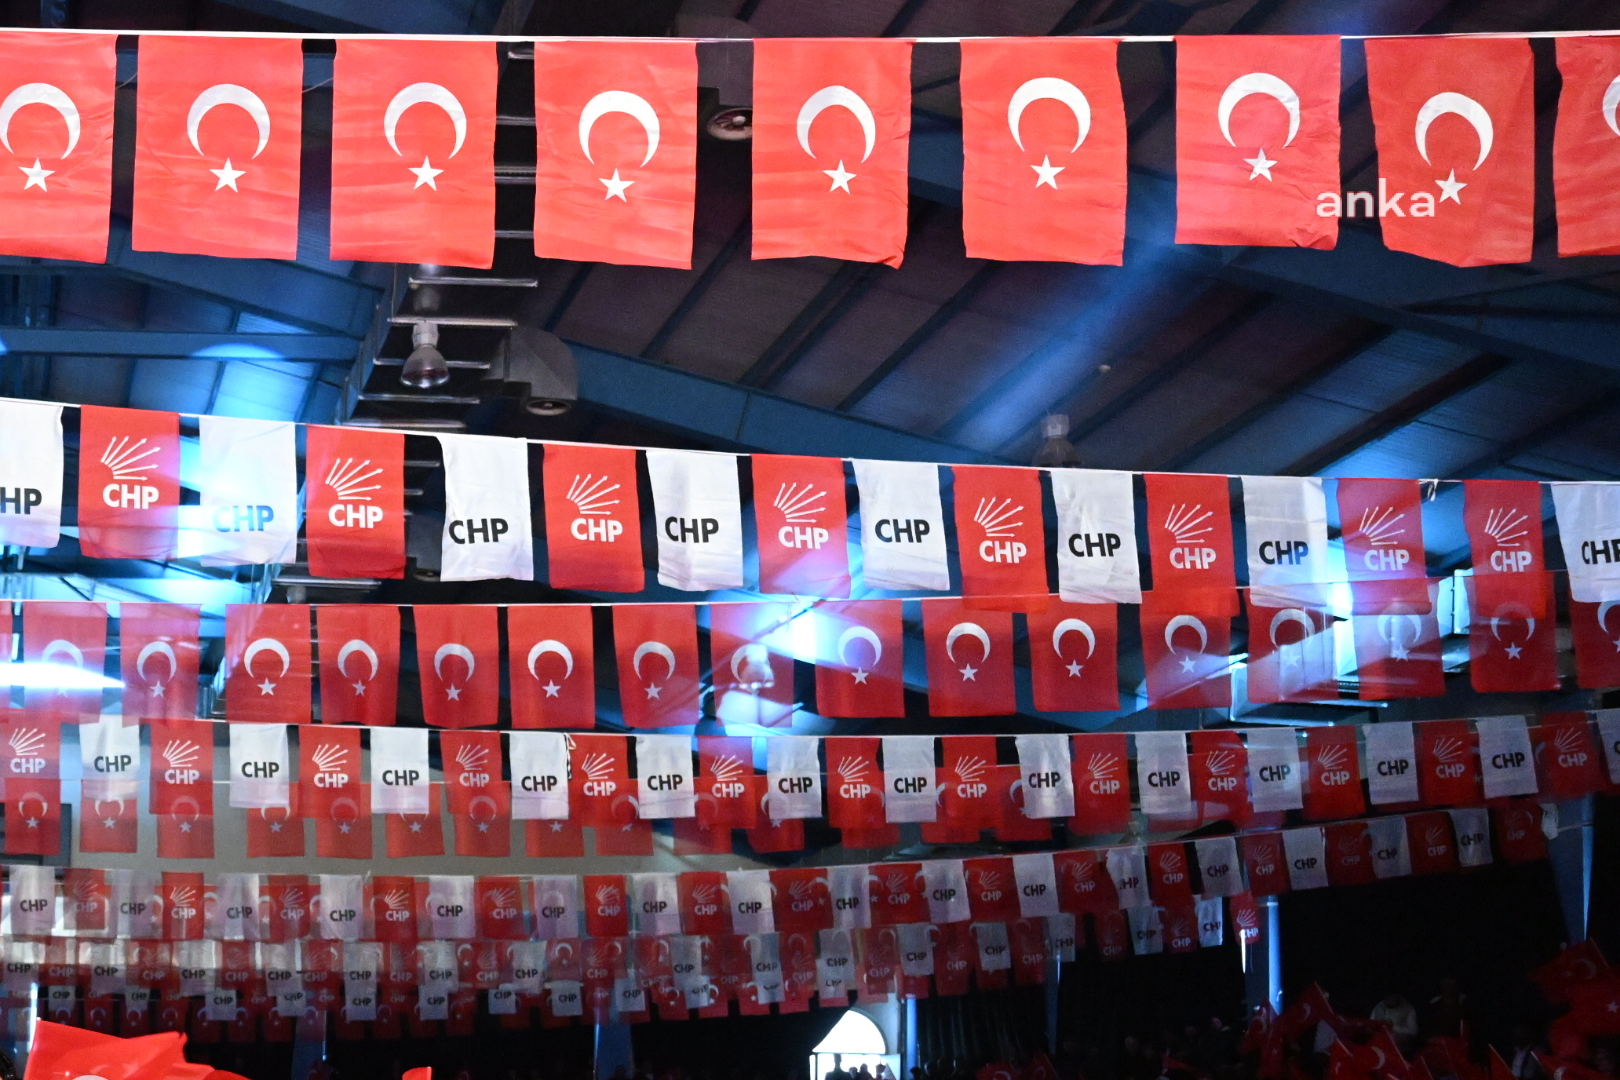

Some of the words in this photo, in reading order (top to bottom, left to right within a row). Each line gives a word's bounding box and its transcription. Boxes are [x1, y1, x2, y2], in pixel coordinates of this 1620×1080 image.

[102, 483, 159, 510] CHP
[212, 505, 274, 533] CHP
[328, 504, 383, 530] CHP
[448, 518, 509, 544] CHP
[570, 518, 623, 543] CHP
[664, 517, 719, 544] CHP
[778, 525, 828, 549] CHP
[874, 519, 930, 543] CHP
[979, 539, 1027, 564] CHP
[1068, 533, 1121, 558] CHP
[1259, 540, 1309, 565] CHP
[1169, 547, 1216, 570] CHP
[1364, 549, 1409, 571] CHP
[1490, 550, 1532, 573] CHP
[10, 758, 46, 773] CHP
[94, 755, 131, 772] CHP
[1492, 753, 1525, 768] CHP
[1558, 753, 1587, 767] CHP
[241, 762, 279, 778] CHP
[1259, 766, 1290, 781] CHP
[1377, 760, 1409, 776] CHP
[1436, 764, 1464, 777] CHP
[165, 769, 199, 784] CHP
[314, 773, 348, 788] CHP
[382, 770, 420, 786] CHP
[459, 772, 489, 787] CHP
[647, 775, 683, 790] CHP
[1028, 773, 1061, 788] CHP
[1148, 771, 1180, 787] CHP
[1321, 772, 1350, 785] CHP
[521, 776, 557, 792] CHP
[584, 781, 616, 796] CHP
[712, 783, 744, 798] CHP
[778, 778, 812, 793] CHP
[840, 784, 871, 798] CHP
[894, 778, 927, 793] CHP
[957, 783, 987, 797] CHP
[1090, 780, 1120, 795] CHP
[1208, 777, 1237, 791] CHP
[1427, 845, 1447, 856] CHP
[1207, 865, 1229, 876] CHP
[1256, 864, 1274, 875] CHP
[1294, 857, 1317, 870] CHP
[1074, 880, 1095, 891] CHP
[1163, 873, 1183, 884] CHP
[933, 889, 956, 900] CHP
[981, 891, 1002, 901] CHP
[1023, 884, 1046, 896] CHP
[20, 899, 47, 912] CHP
[791, 900, 814, 911] CHP
[836, 898, 859, 909] CHP
[888, 893, 910, 904] CHP
[120, 902, 146, 915] CHP
[171, 908, 196, 919] CHP
[226, 907, 253, 919] CHP
[437, 904, 463, 917] CHP
[493, 907, 516, 919] CHP
[542, 907, 564, 918] CHP
[598, 905, 620, 916] CHP
[643, 901, 667, 913] CHP
[694, 904, 717, 915] CHP
[738, 902, 762, 913] CHP
[280, 909, 304, 920] CHP
[330, 910, 356, 922] CHP
[385, 910, 410, 921] CHP
[985, 944, 1005, 955] CHP
[1172, 938, 1191, 948] CHP
[827, 957, 848, 968] CHP
[94, 966, 118, 977] CHP
[268, 970, 292, 981] CHP
[429, 970, 452, 980] CHP
[515, 969, 538, 979] CHP
